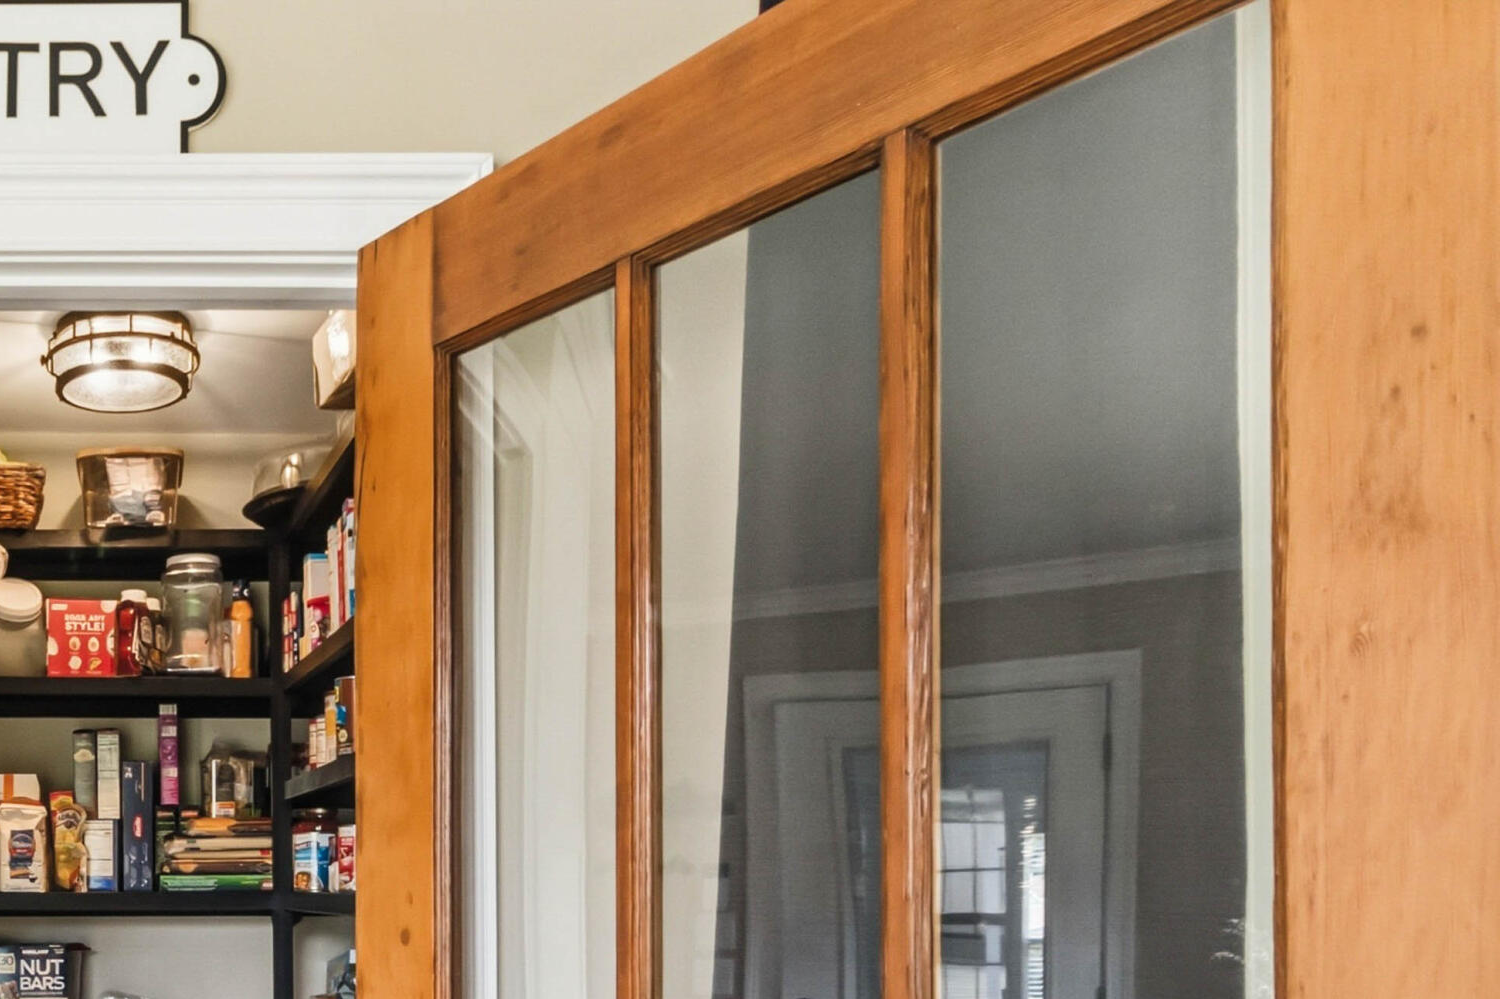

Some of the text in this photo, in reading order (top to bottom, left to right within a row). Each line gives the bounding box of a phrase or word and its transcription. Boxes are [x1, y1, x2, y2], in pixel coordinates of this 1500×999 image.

[64, 621, 106, 632] STYLE!
[19, 958, 65, 976] NUT
[19, 976, 66, 991] BARS
